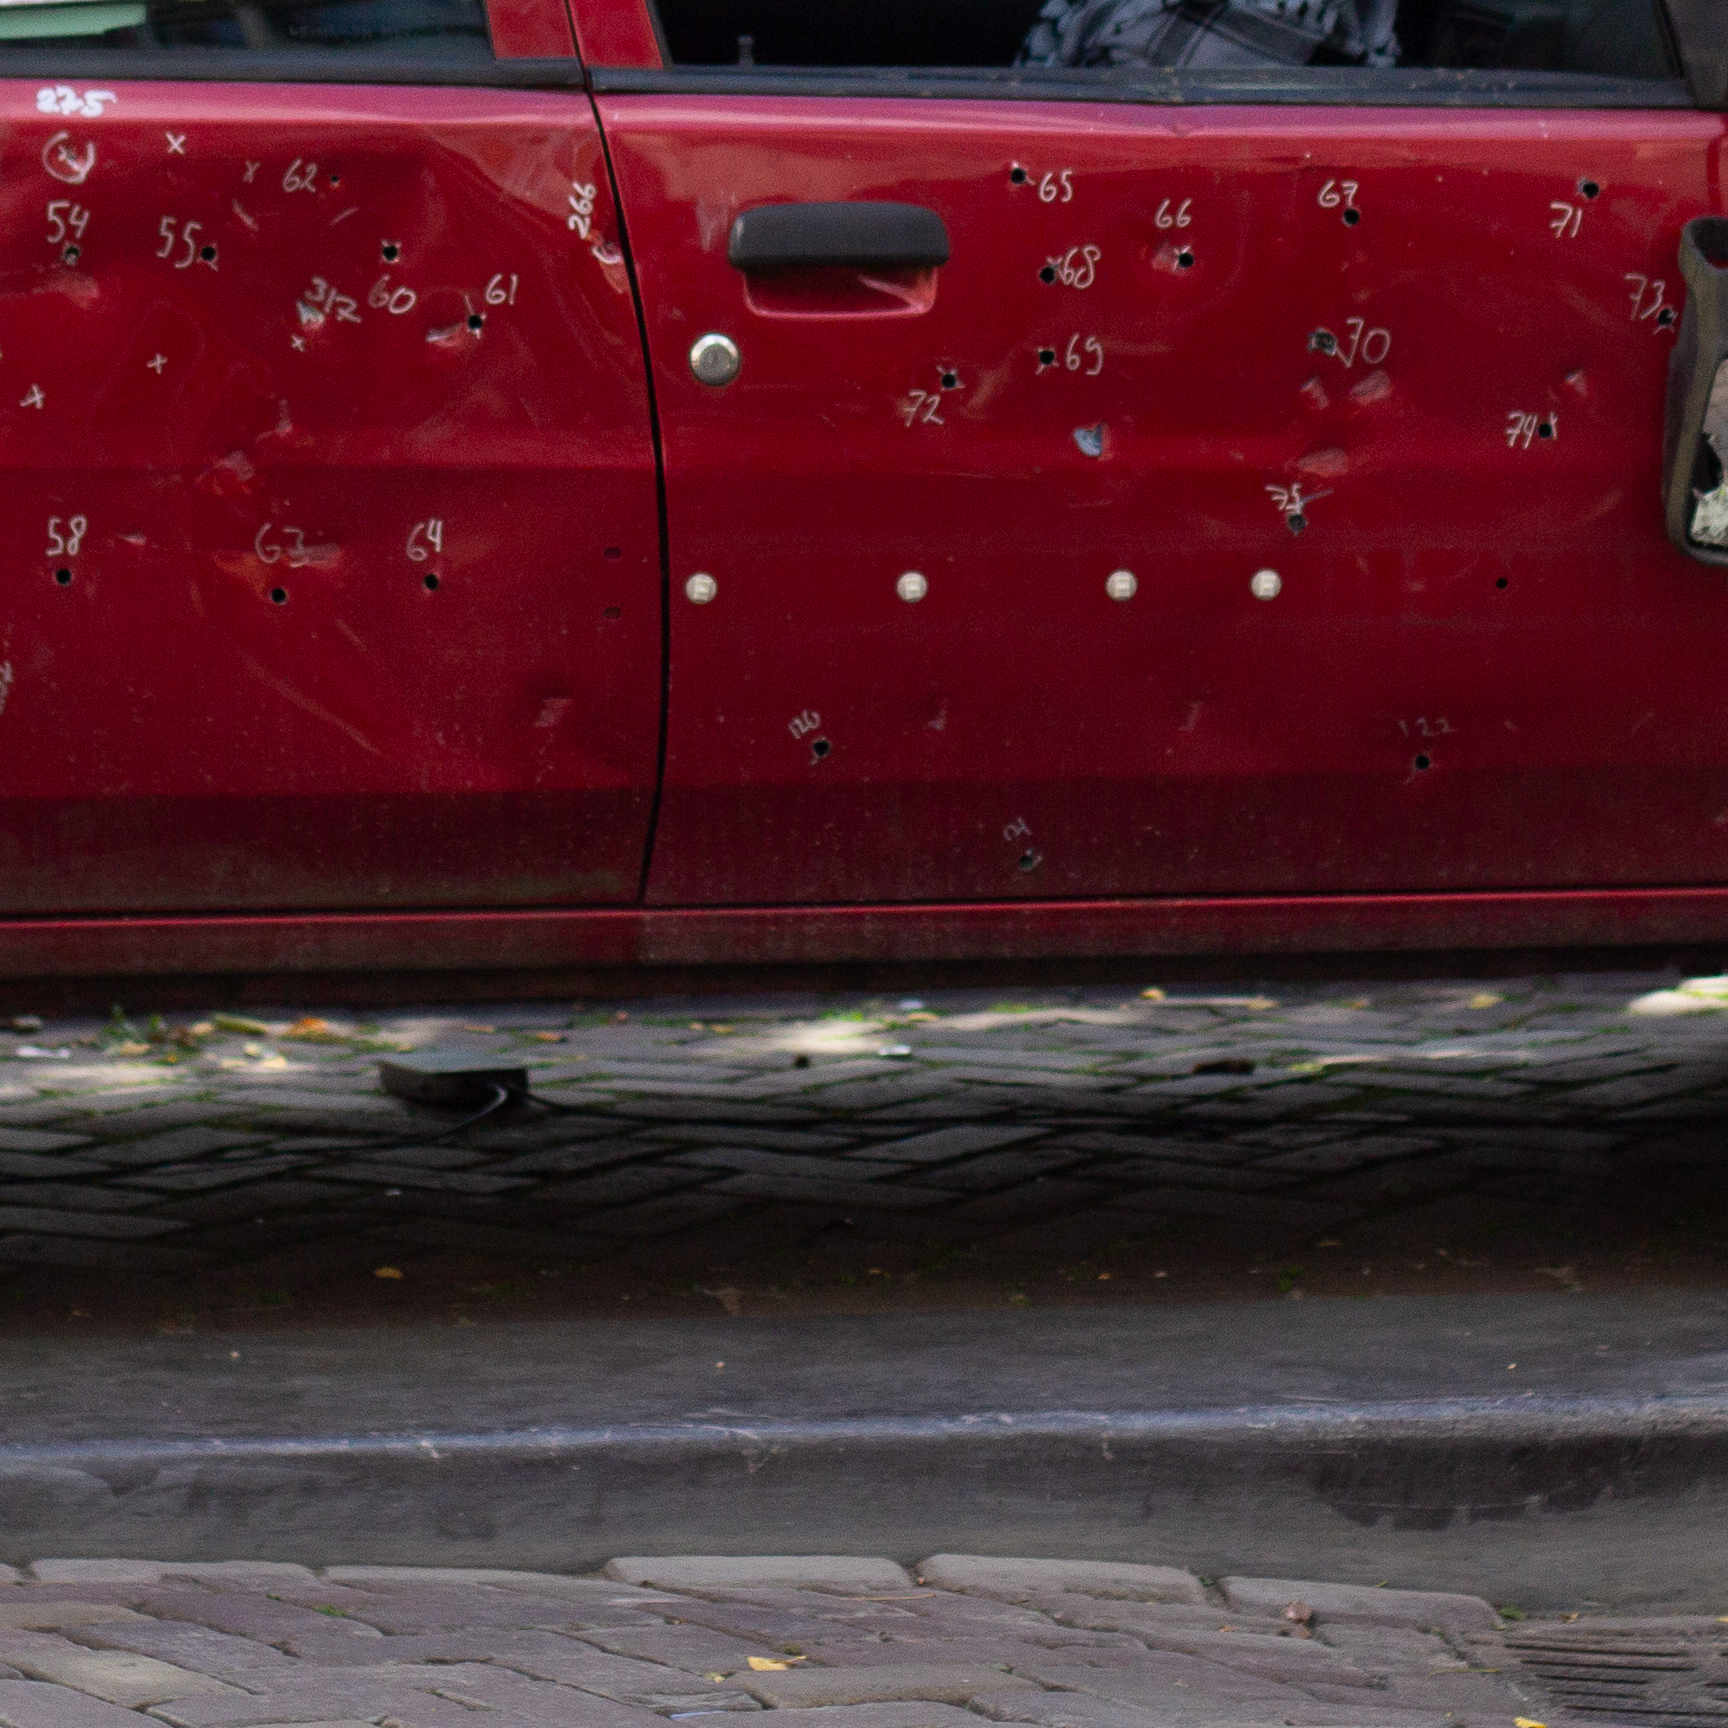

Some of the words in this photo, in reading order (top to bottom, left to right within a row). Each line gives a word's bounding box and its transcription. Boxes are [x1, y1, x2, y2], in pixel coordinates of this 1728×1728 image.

[282, 157, 319, 193] 62
[1037, 169, 1073, 203] 65
[1317, 179, 1359, 209] 67
[45, 200, 91, 244] 54
[567, 181, 598, 240] 266
[1153, 198, 1193, 229] 66
[1549, 200, 1584, 238] 71
[155, 215, 203, 270] 55
[1059, 243, 1103, 290] 68
[368, 273, 418, 315] 60
[484, 273, 519, 306] 61
[1624, 273, 1667, 320] 73
[1064, 332, 1105, 376] 69
[1345, 315, 1392, 368] 70
[902, 388, 946, 428] 72
[1504, 409, 1539, 450] 74
[1264, 482, 1303, 513] 75
[45, 514, 89, 557] 58
[406, 517, 445, 562] 64
